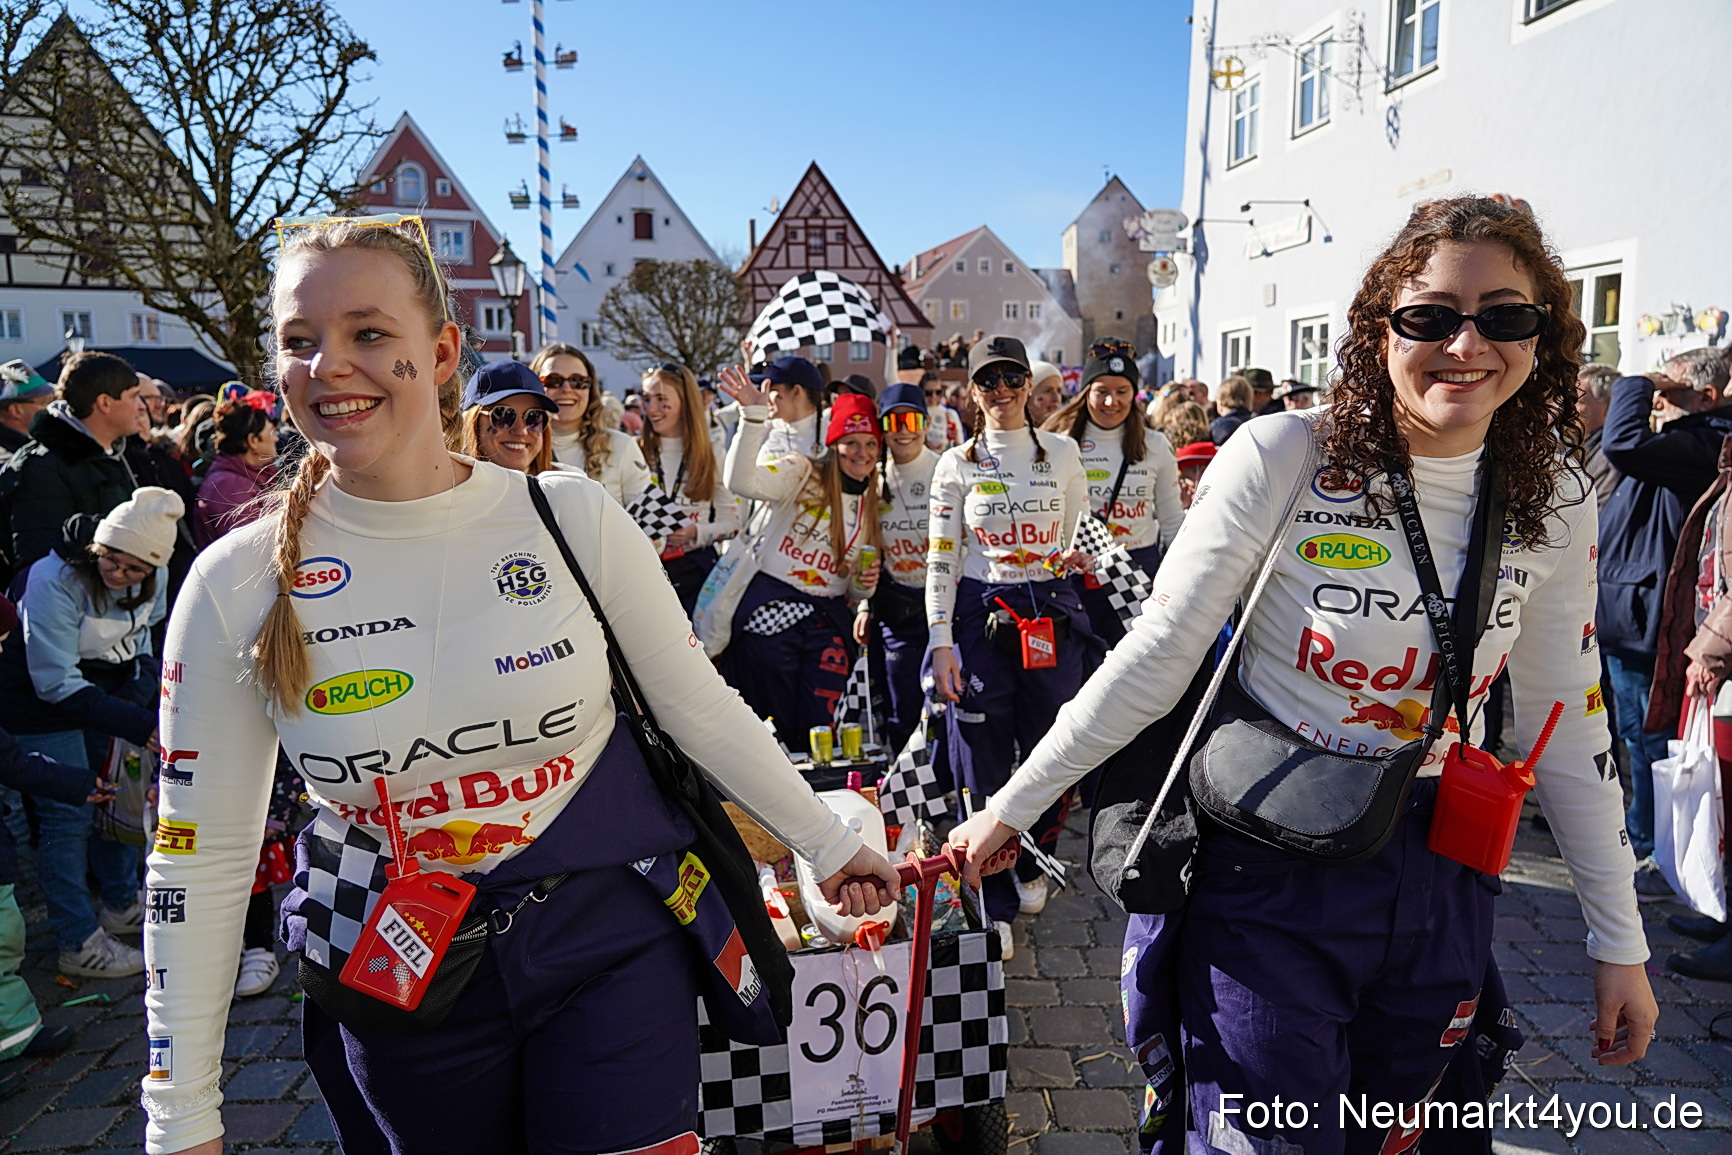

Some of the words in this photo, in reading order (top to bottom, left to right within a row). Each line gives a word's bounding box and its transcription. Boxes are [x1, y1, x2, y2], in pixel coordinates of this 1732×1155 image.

[974, 499, 1061, 517] ORACLE
[1112, 501, 1146, 519] Bull
[1294, 510, 1396, 531] HONDA
[974, 523, 1017, 546] Red
[1021, 521, 1061, 544] Bull
[1400, 500, 1430, 565] FICKEN
[778, 535, 819, 566] Red
[1320, 542, 1382, 561] RAUCH
[497, 566, 547, 594] HSG
[517, 584, 553, 606] POLLANTEN
[1313, 584, 1514, 630] ORAE
[494, 645, 555, 676] Mobil
[1030, 639, 1051, 651] FUEL
[1296, 626, 1419, 692] Red
[1435, 621, 1460, 686] FICKEN
[329, 674, 402, 705] RAUCH
[299, 701, 579, 783] ORACLE
[458, 755, 576, 810] Bull
[382, 917, 428, 970] FUEL
[799, 974, 899, 1064] 36
[856, 1100, 881, 1108] Brching
